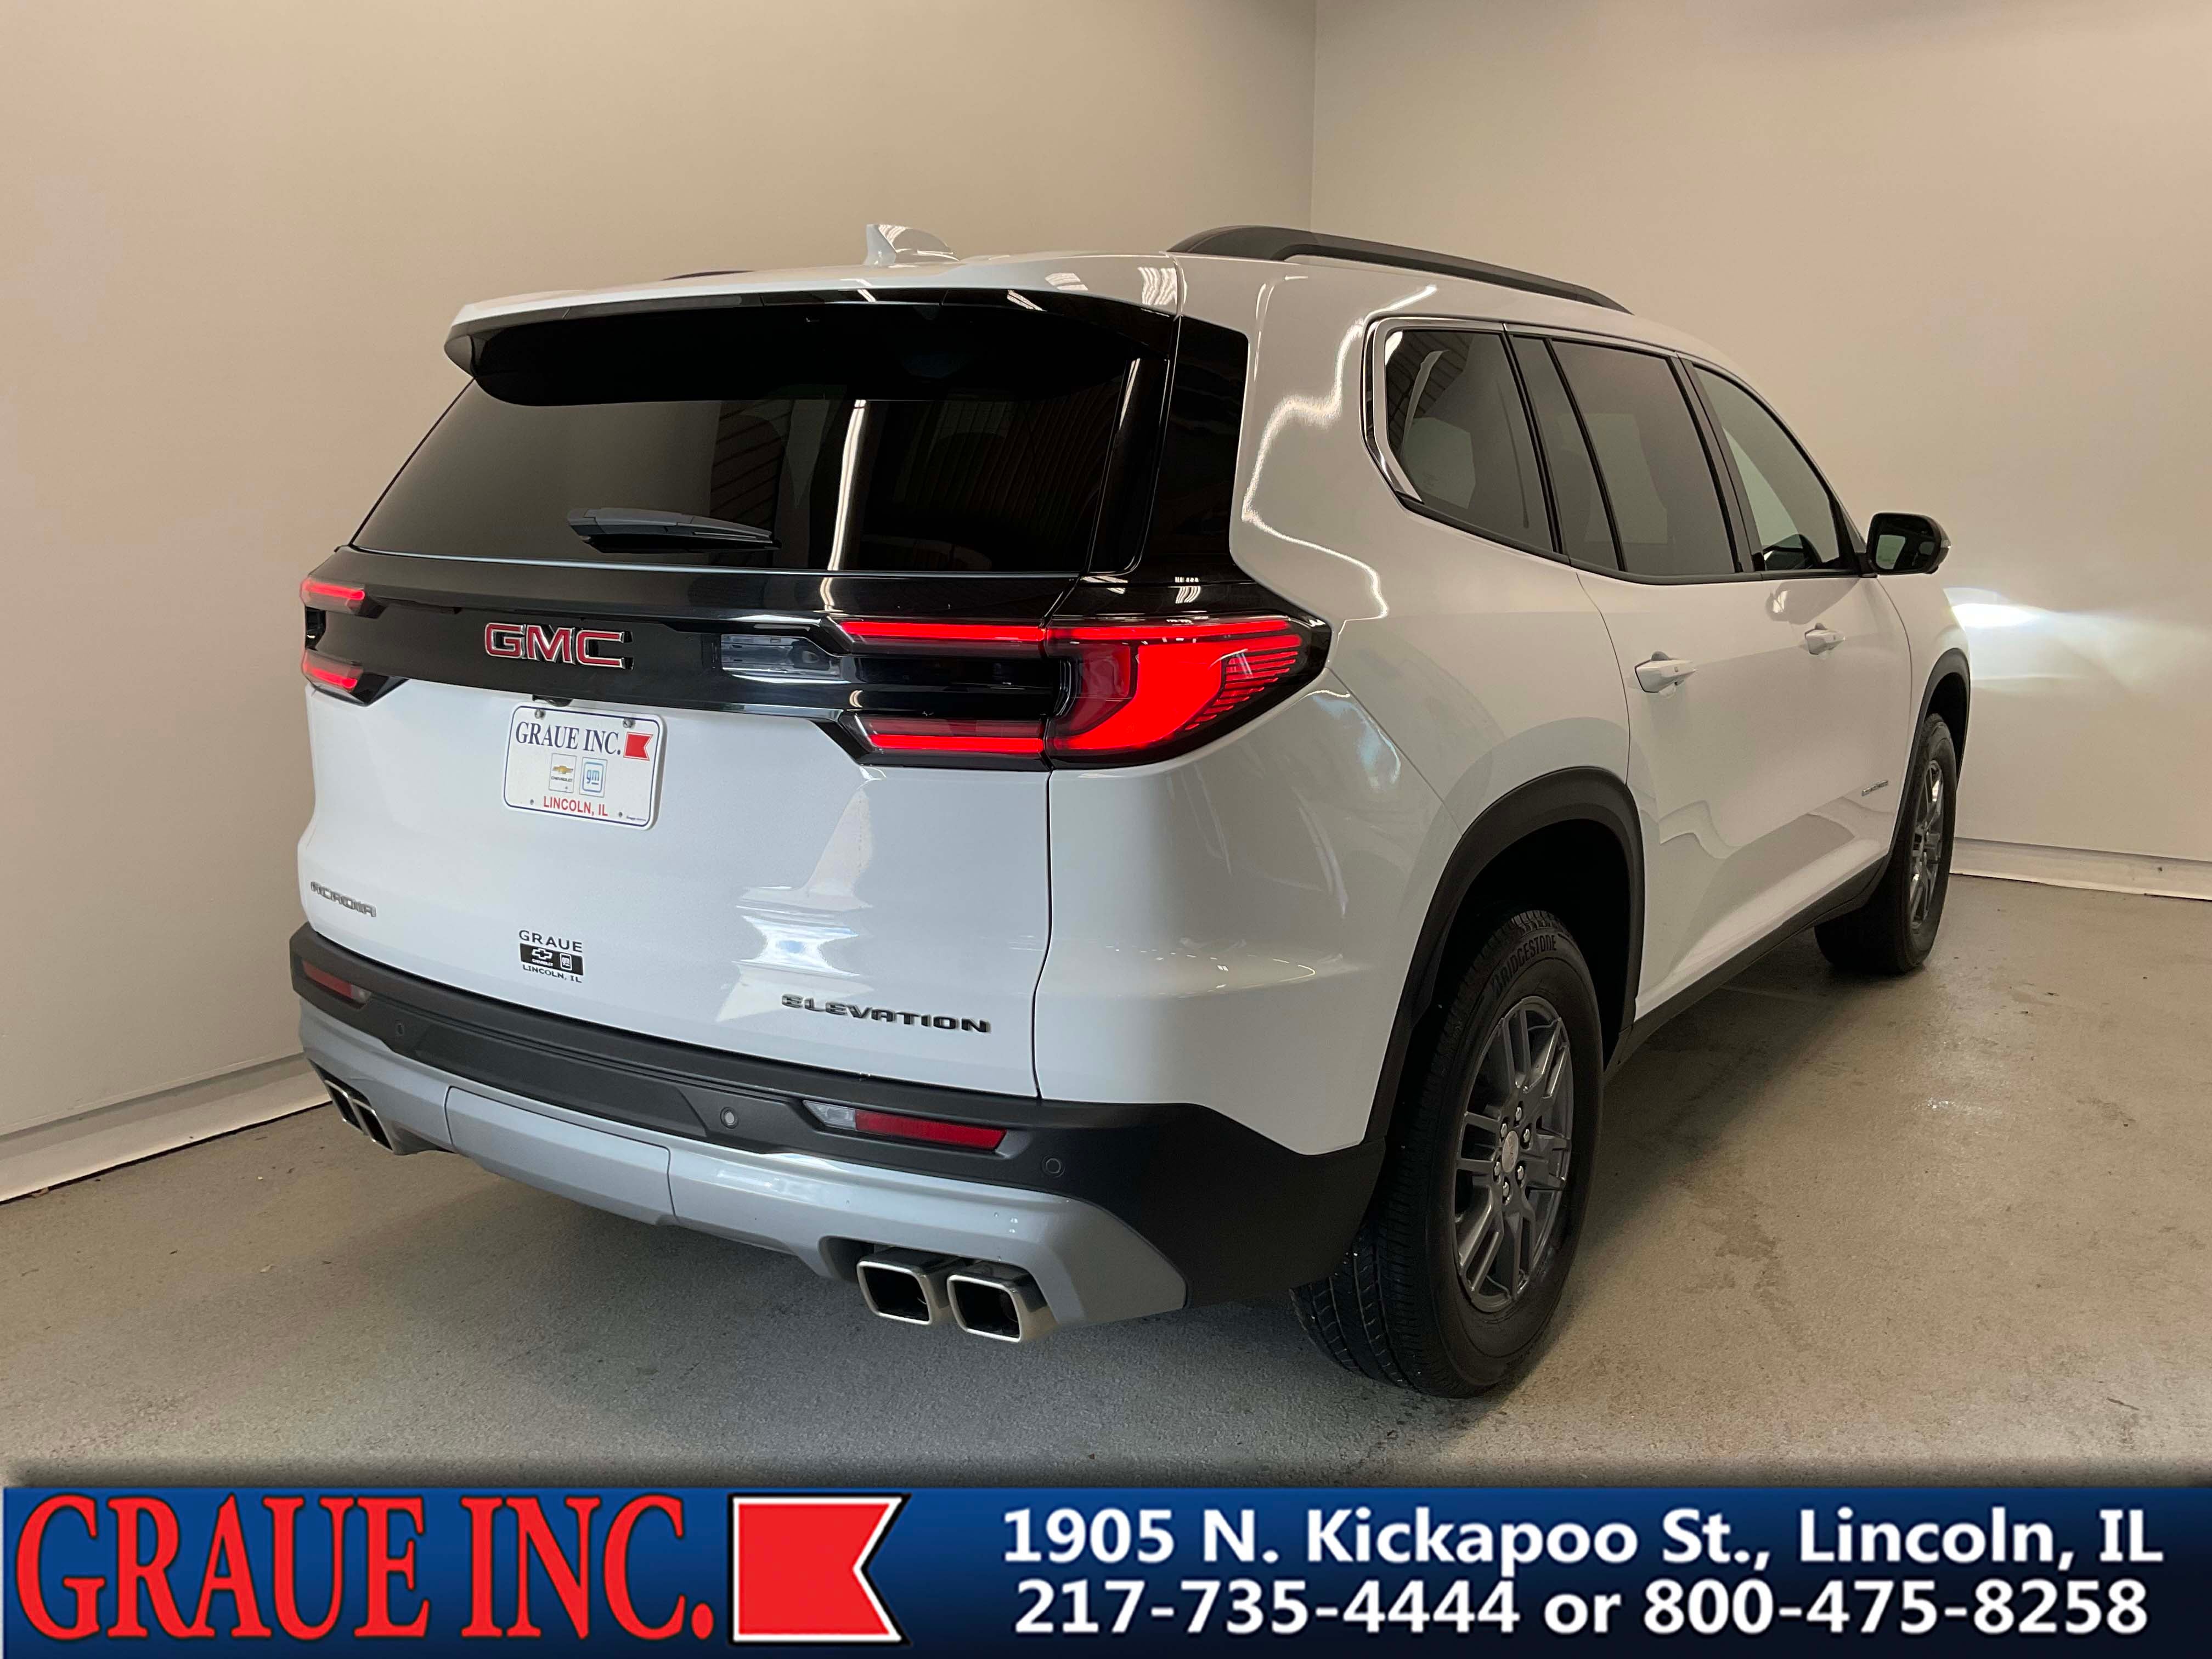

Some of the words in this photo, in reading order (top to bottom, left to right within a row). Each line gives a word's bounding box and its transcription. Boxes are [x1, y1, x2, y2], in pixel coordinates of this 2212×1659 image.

[484, 622, 631, 669] GMC
[515, 721, 580, 750] GRAUE
[583, 729, 622, 755] INC.
[543, 795, 595, 817] LINCOLN,
[598, 804, 608, 817] IL
[311, 881, 377, 918] ACADIA
[518, 929, 583, 953] GRAUE
[522, 964, 567, 980] LINCOLN,
[570, 975, 583, 983] IL
[1492, 934, 1558, 1001] BRIDGESTONE
[781, 993, 991, 1034] ELEVATION
